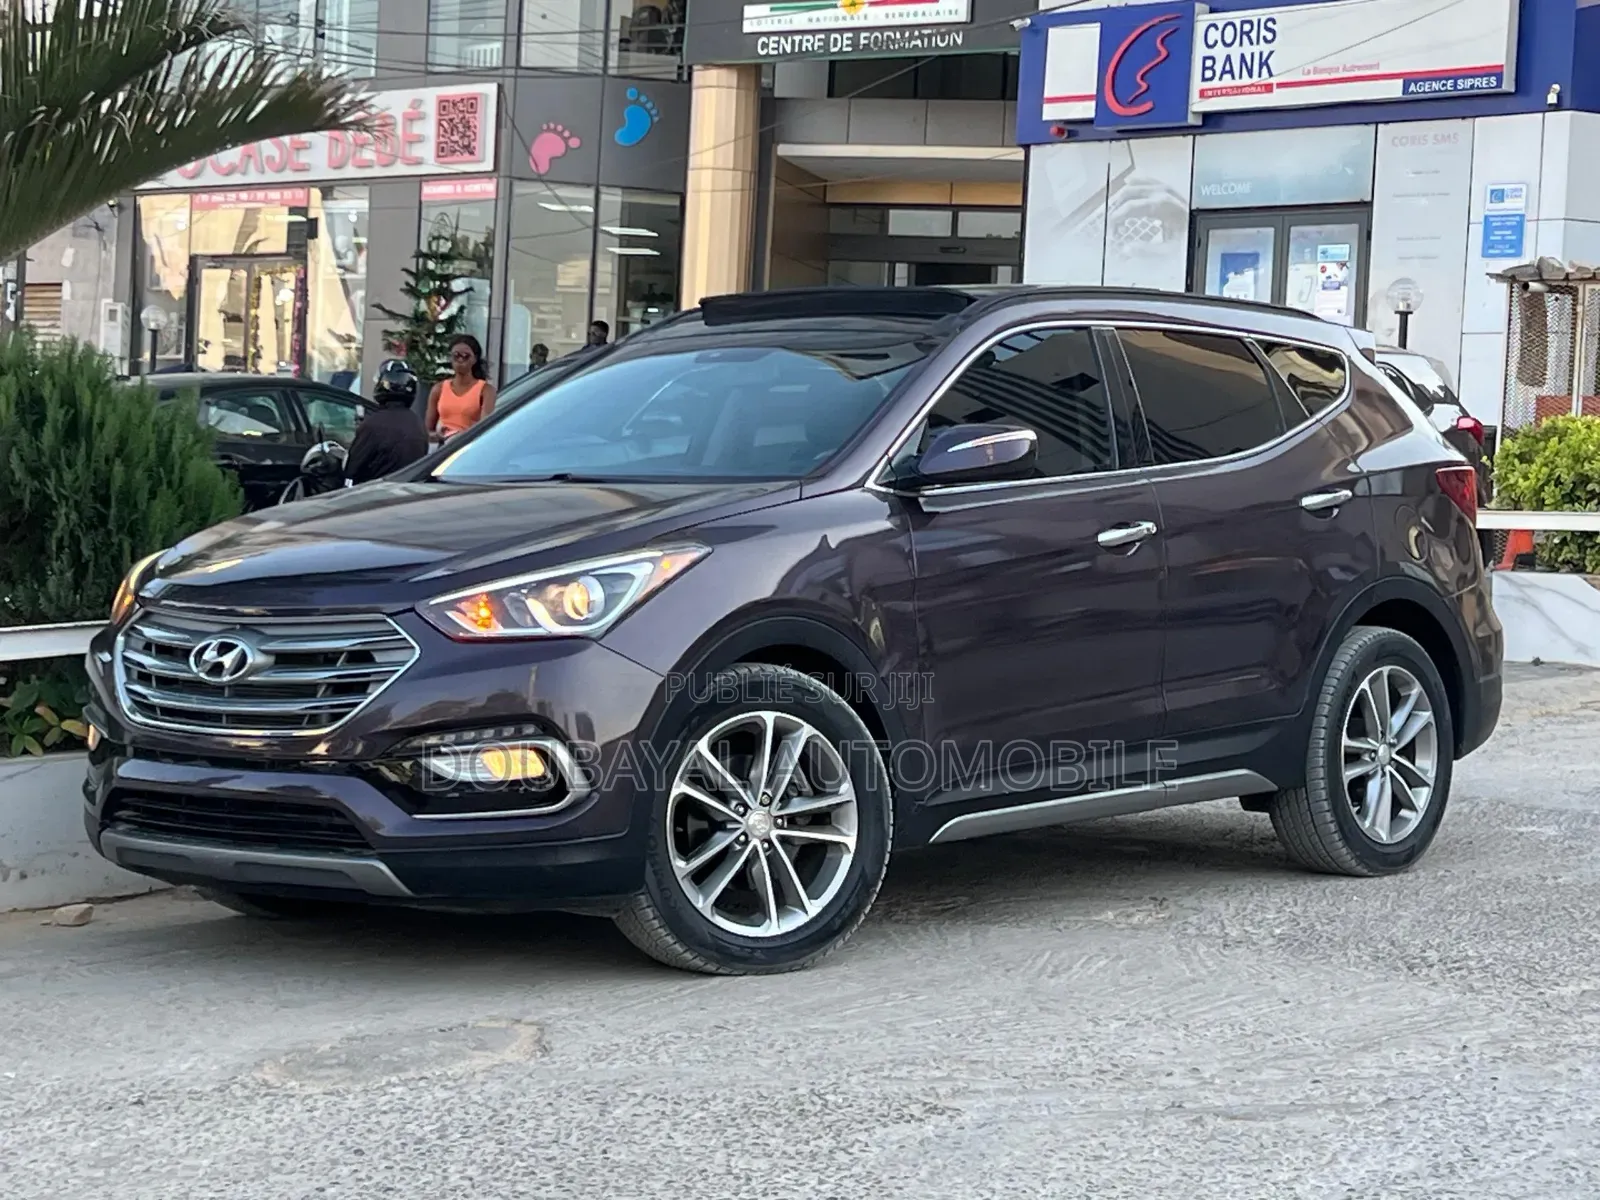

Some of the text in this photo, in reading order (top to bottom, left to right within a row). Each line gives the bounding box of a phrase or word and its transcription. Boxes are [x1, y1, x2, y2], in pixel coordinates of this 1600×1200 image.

[757, 28, 963, 55] CENTRE DE FORMATION
[1204, 17, 1277, 49] CORIS
[1201, 50, 1275, 82] BANK
[1408, 76, 1497, 93] AGENCE SIPRES
[1391, 132, 1460, 147] CORIS SMS
